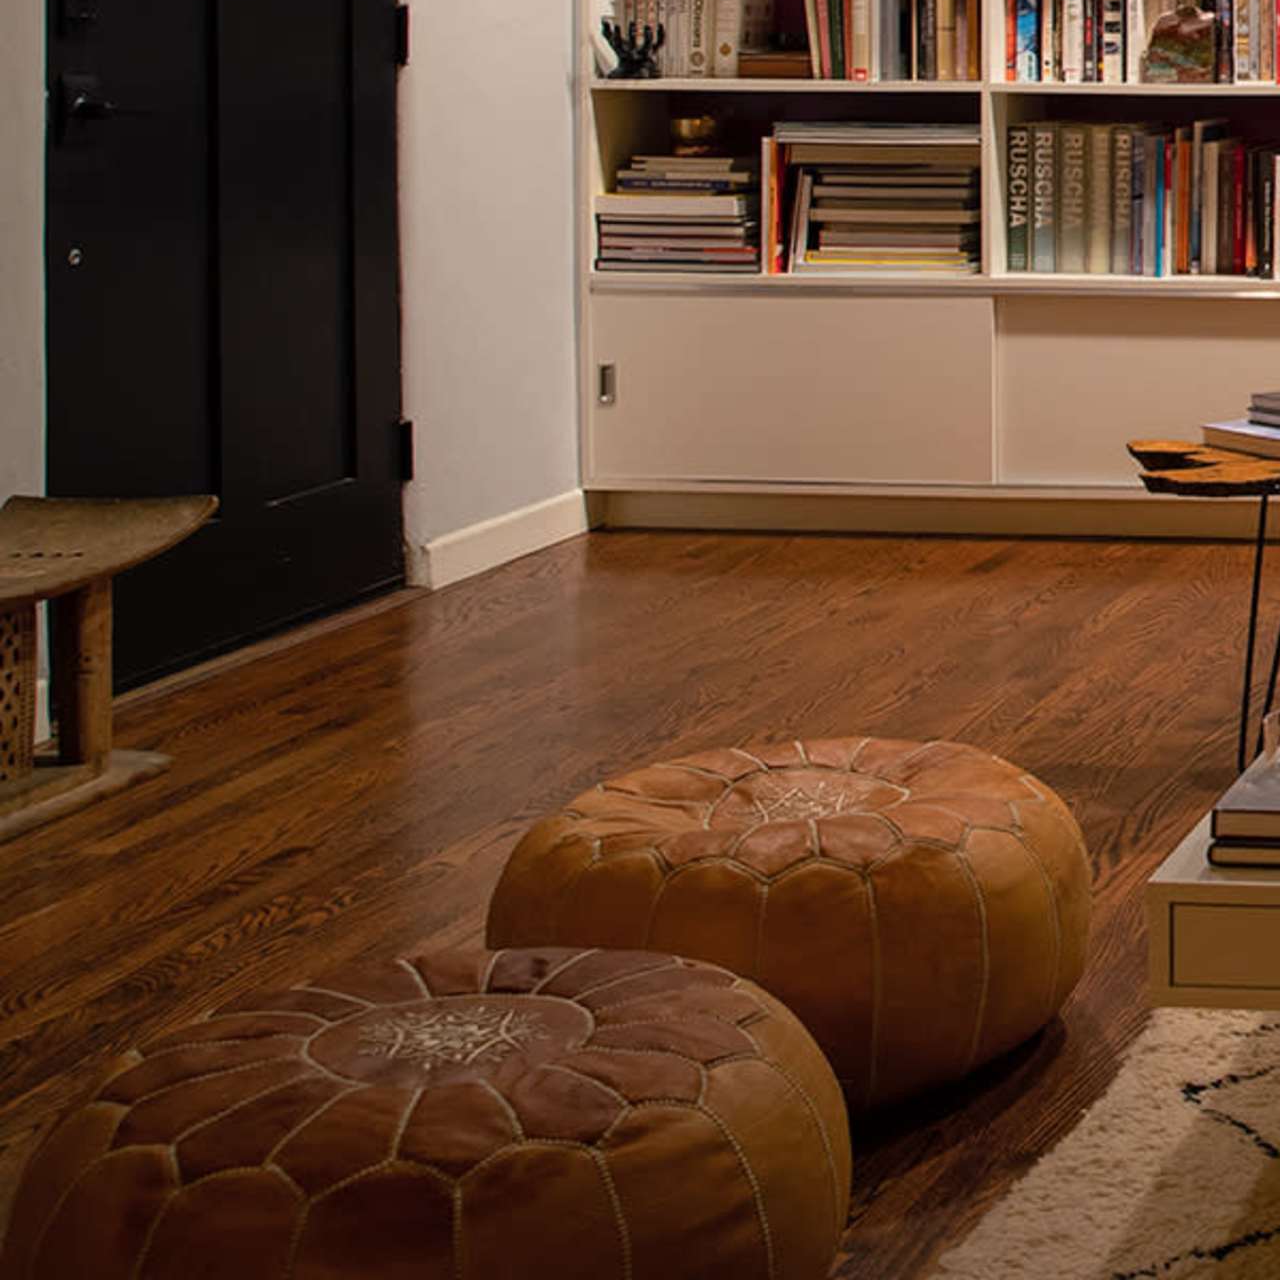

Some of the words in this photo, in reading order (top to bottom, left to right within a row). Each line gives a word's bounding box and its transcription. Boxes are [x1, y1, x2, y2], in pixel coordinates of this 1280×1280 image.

[1009, 129, 1029, 228] RUSCHA
[1033, 131, 1053, 228] RUSCHA
[1064, 132, 1084, 228] RUSCHA
[1115, 132, 1131, 227] RUSCHA
